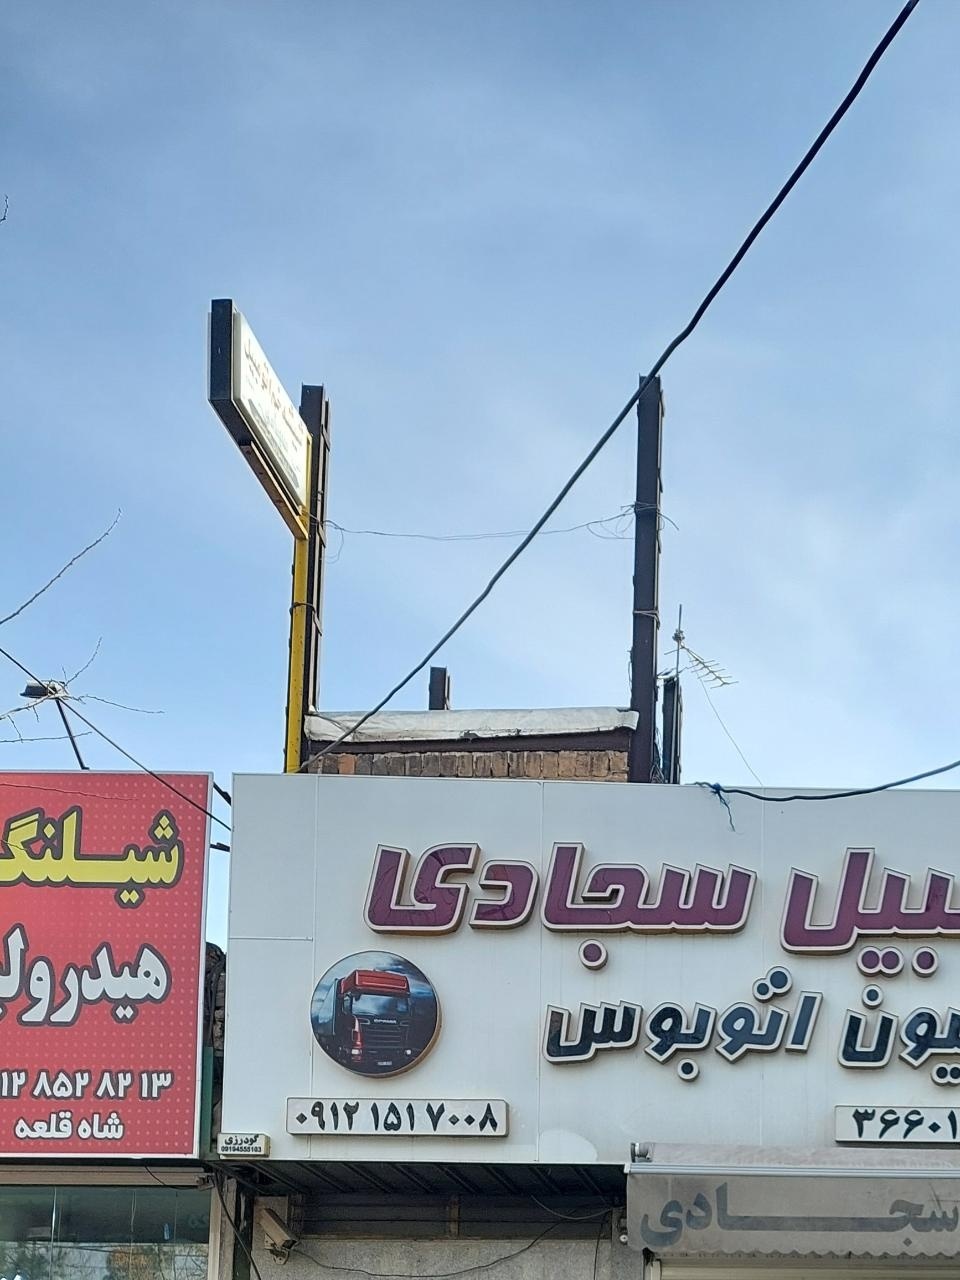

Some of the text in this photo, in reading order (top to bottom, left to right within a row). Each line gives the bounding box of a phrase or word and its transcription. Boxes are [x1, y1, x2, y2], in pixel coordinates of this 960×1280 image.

[362, 842, 757, 970] سجادی
[0, 926, 169, 1023] هیدرول
[542, 966, 823, 1083] اتوبوس
[15, 1111, 124, 1139] شاه قلعه
[640, 1183, 960, 1247] سجادی
